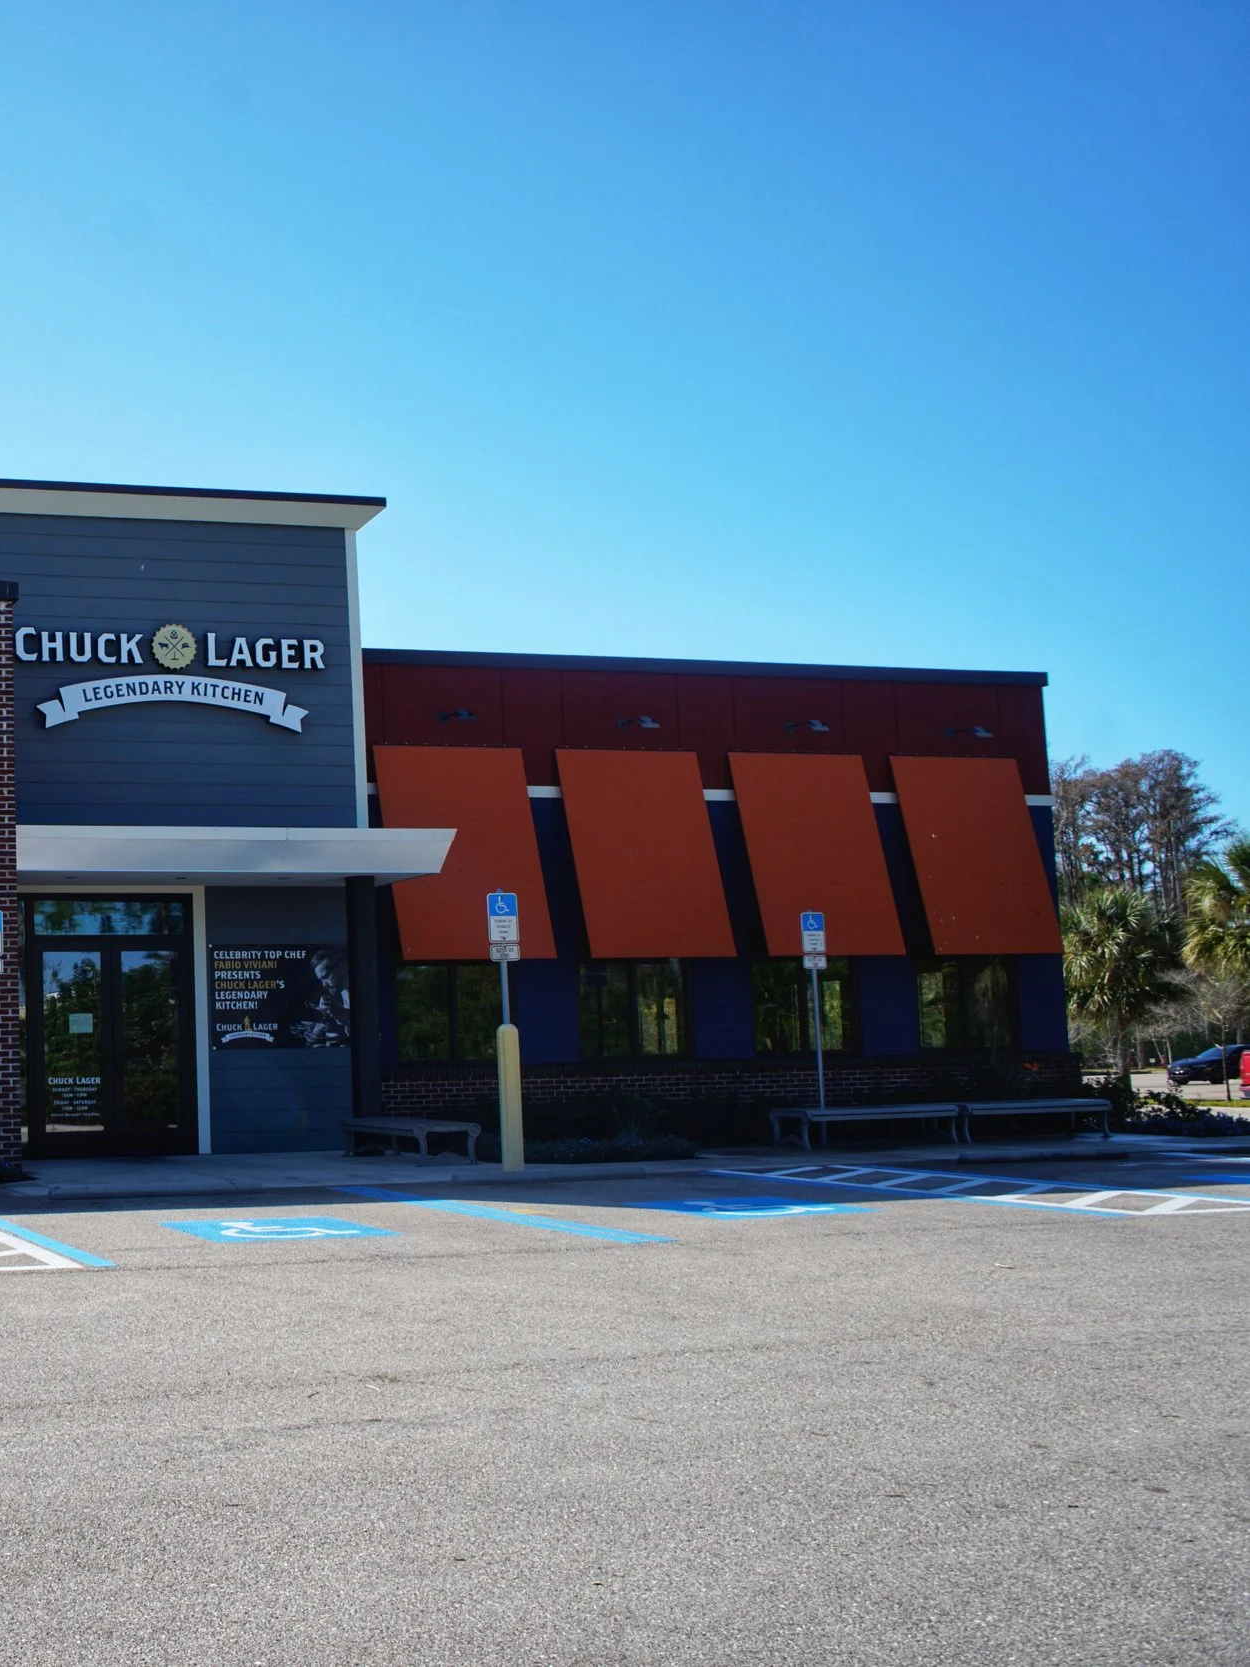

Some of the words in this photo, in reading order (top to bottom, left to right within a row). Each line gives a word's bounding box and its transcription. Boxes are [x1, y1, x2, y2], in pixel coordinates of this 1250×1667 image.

[15, 626, 144, 664] CHUCK
[206, 632, 326, 669] LAGER
[81, 680, 186, 703] LEGENDARY
[191, 681, 265, 706] KITCHEN
[214, 950, 262, 960] CELEBRITY
[263, 950, 282, 959] TOP
[284, 950, 307, 959] CHEF
[214, 961, 242, 969] FABIO
[243, 960, 277, 969] VIVIANI
[214, 970, 261, 979] PRESENTS
[215, 981, 246, 990] CHUCK
[248, 980, 285, 989] LAGER'S
[215, 991, 268, 1000] LEGENDARY
[215, 1001, 258, 1010] KITCHEN!
[216, 1023, 243, 1031] CHUCK
[253, 1022, 278, 1031] LAGER
[48, 1077, 74, 1085] CHUCK
[76, 1076, 101, 1085] LAGER
